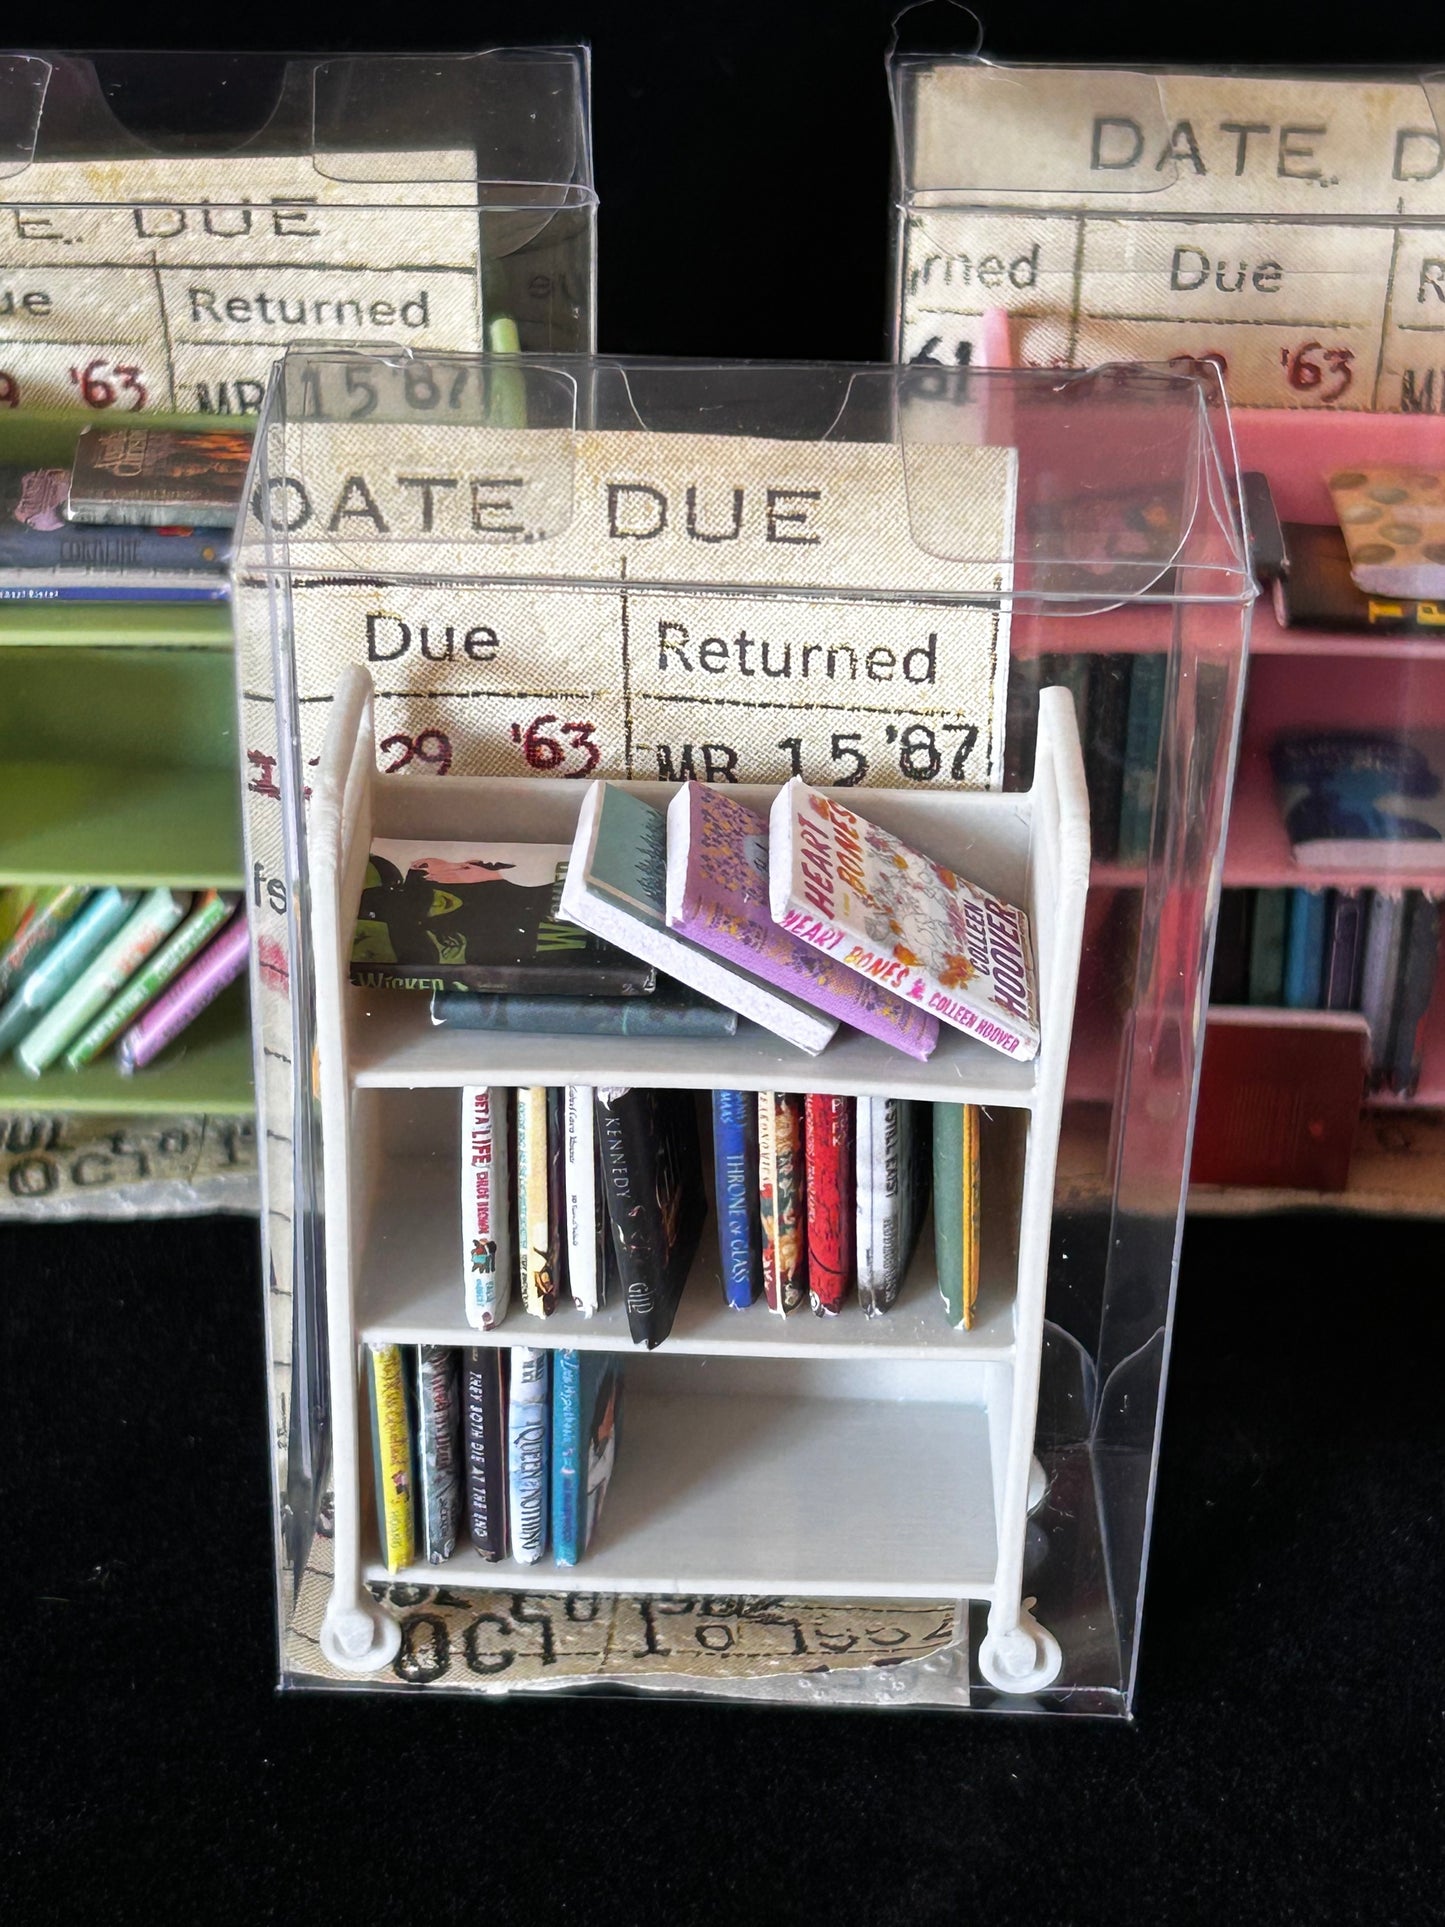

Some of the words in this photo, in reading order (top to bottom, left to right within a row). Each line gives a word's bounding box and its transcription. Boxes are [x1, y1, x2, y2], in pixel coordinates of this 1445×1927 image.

[1170, 244, 1283, 294] Due
[188, 285, 431, 331] Returned
[606, 481, 823, 546] DUE
[365, 609, 500, 663] Due
[658, 619, 938, 685] Returned
[797, 811, 835, 920] HEART
[826, 799, 867, 900] BONES
[962, 898, 991, 976] COLLEEN
[985, 898, 1028, 1020] HOOVER
[843, 945, 910, 989] BONES
[928, 990, 977, 1029] COLLEEN
[974, 1018, 1020, 1054] HOOVER
[474, 1093, 490, 1115] GET
[474, 1115, 490, 1125] A
[604, 1116, 631, 1199] KENNEDY
[726, 1153, 748, 1216] THRONE
[729, 1238, 750, 1284] GLASS
[628, 1281, 655, 1315] GILD
[469, 1371, 483, 1401] THEY
[472, 1465, 487, 1483] AT
[513, 1424, 546, 1479] QUEEN
